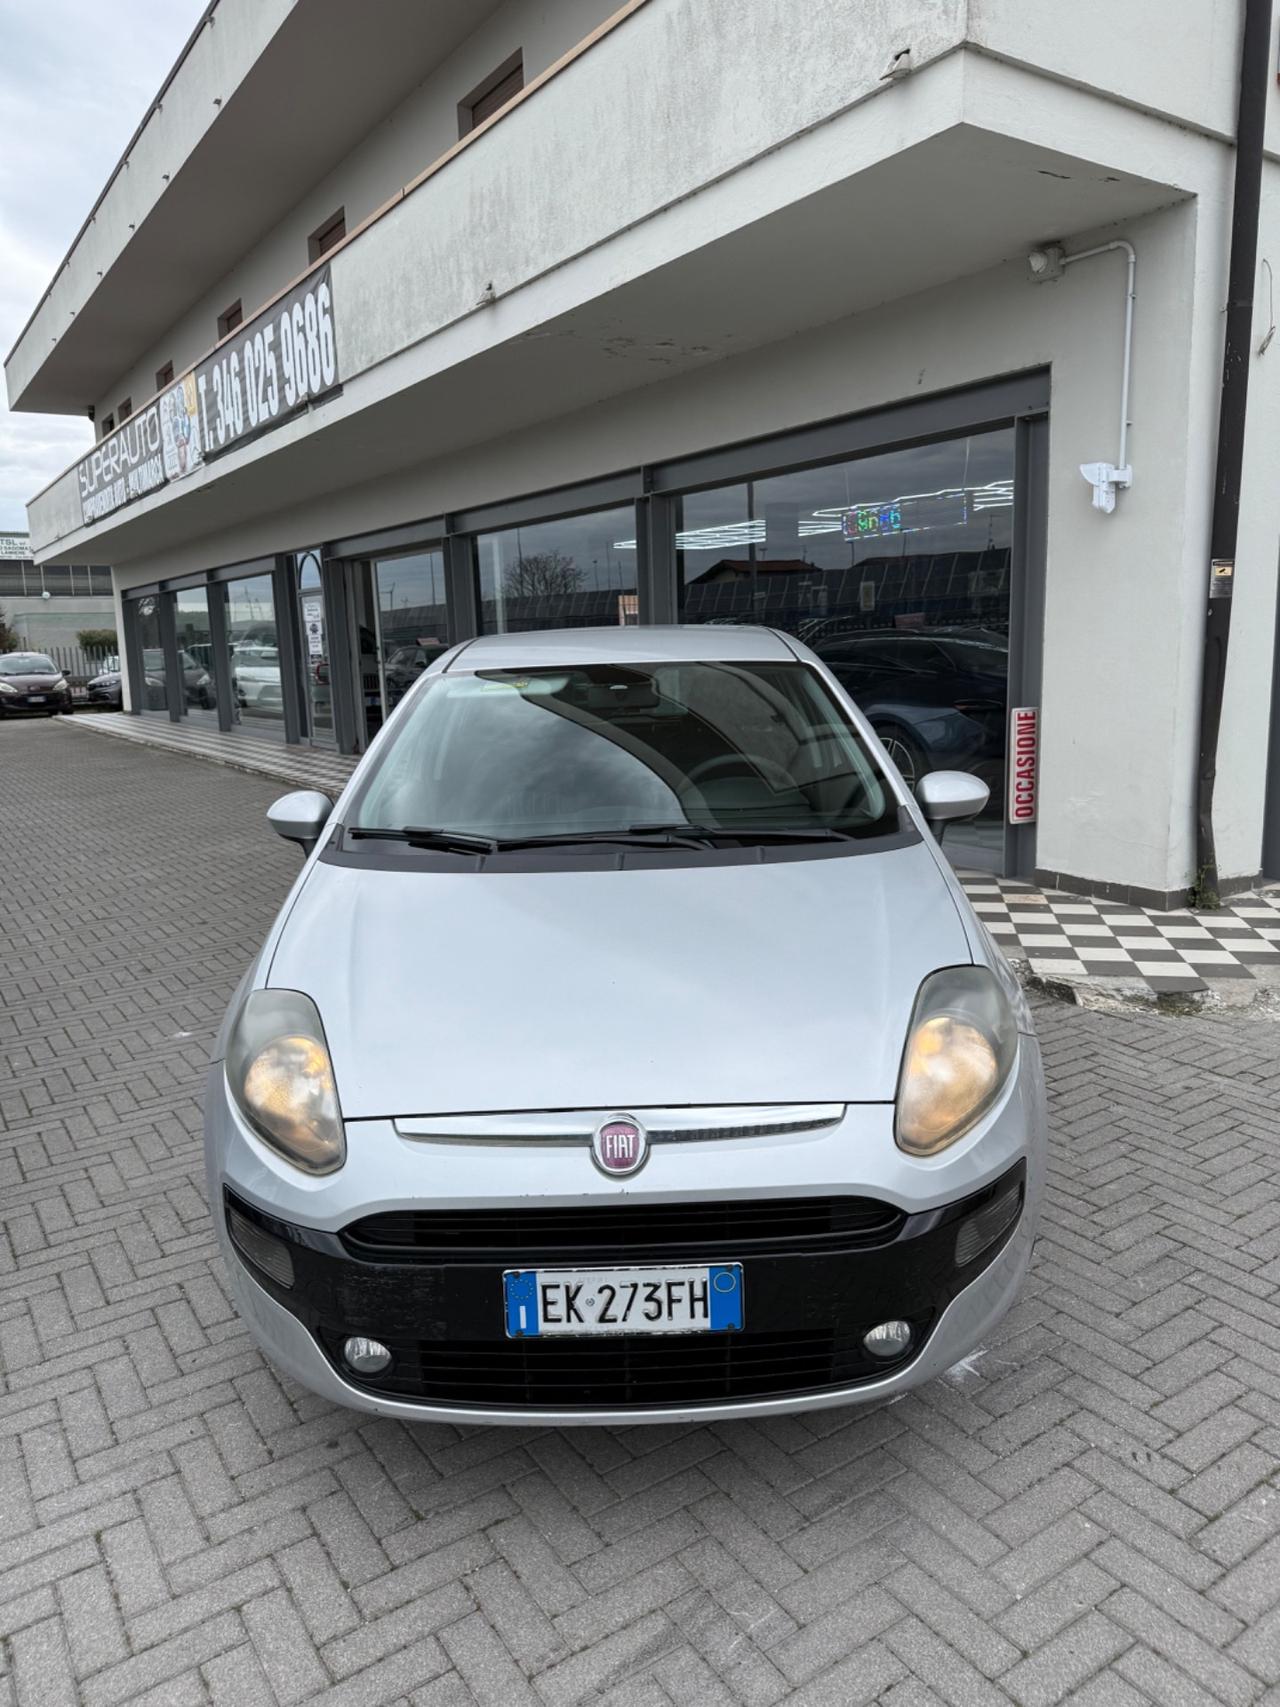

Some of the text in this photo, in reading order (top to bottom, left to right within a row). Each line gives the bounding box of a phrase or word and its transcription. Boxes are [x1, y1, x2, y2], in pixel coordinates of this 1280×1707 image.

[198, 283, 335, 452] T. 346 025 9686
[79, 406, 160, 498] SUPERAUTO
[1015, 711, 1036, 818] OCCASIONE
[606, 1134, 635, 1159] FIAT
[541, 1281, 585, 1323] EK
[597, 1277, 709, 1323] 273FH
